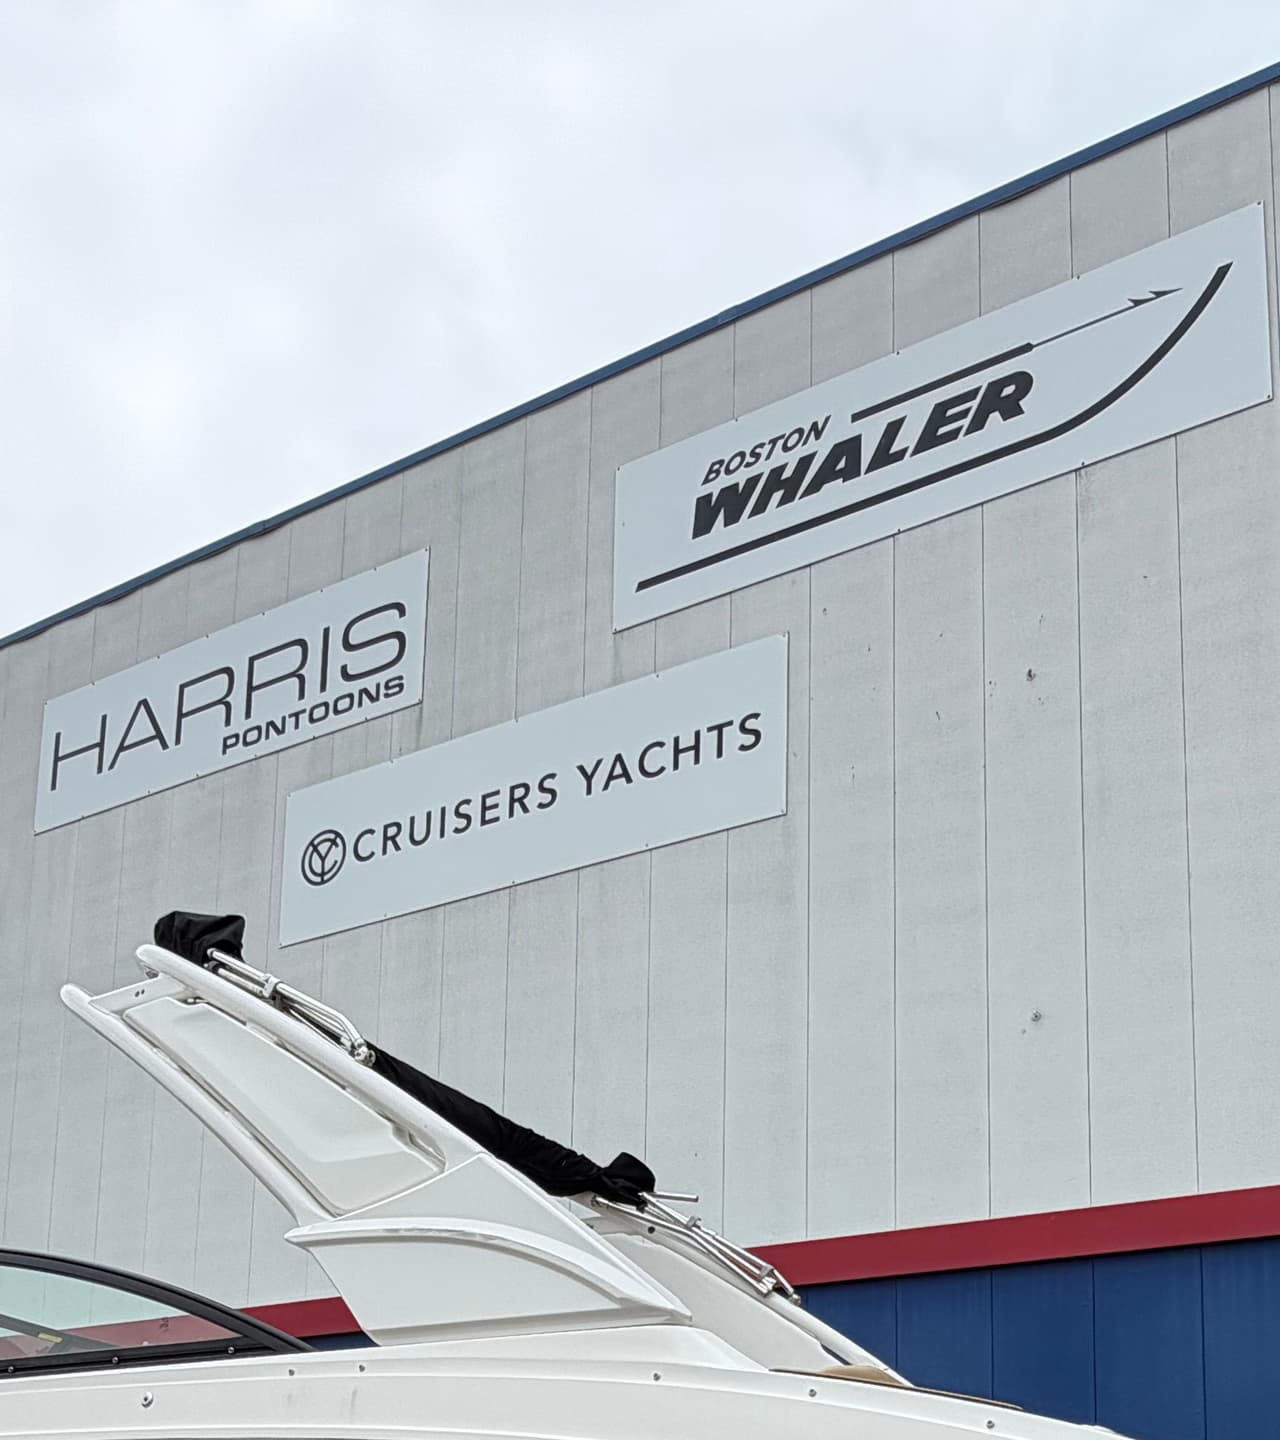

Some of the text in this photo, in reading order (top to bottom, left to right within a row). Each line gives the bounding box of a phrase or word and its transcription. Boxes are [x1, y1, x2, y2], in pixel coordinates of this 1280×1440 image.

[691, 370, 1034, 541] WHALER
[701, 415, 831, 486] BOSTON
[49, 601, 408, 792] HARRIS
[222, 675, 405, 756] PONTOONS
[353, 712, 762, 862] CRUISERS YACHTS
